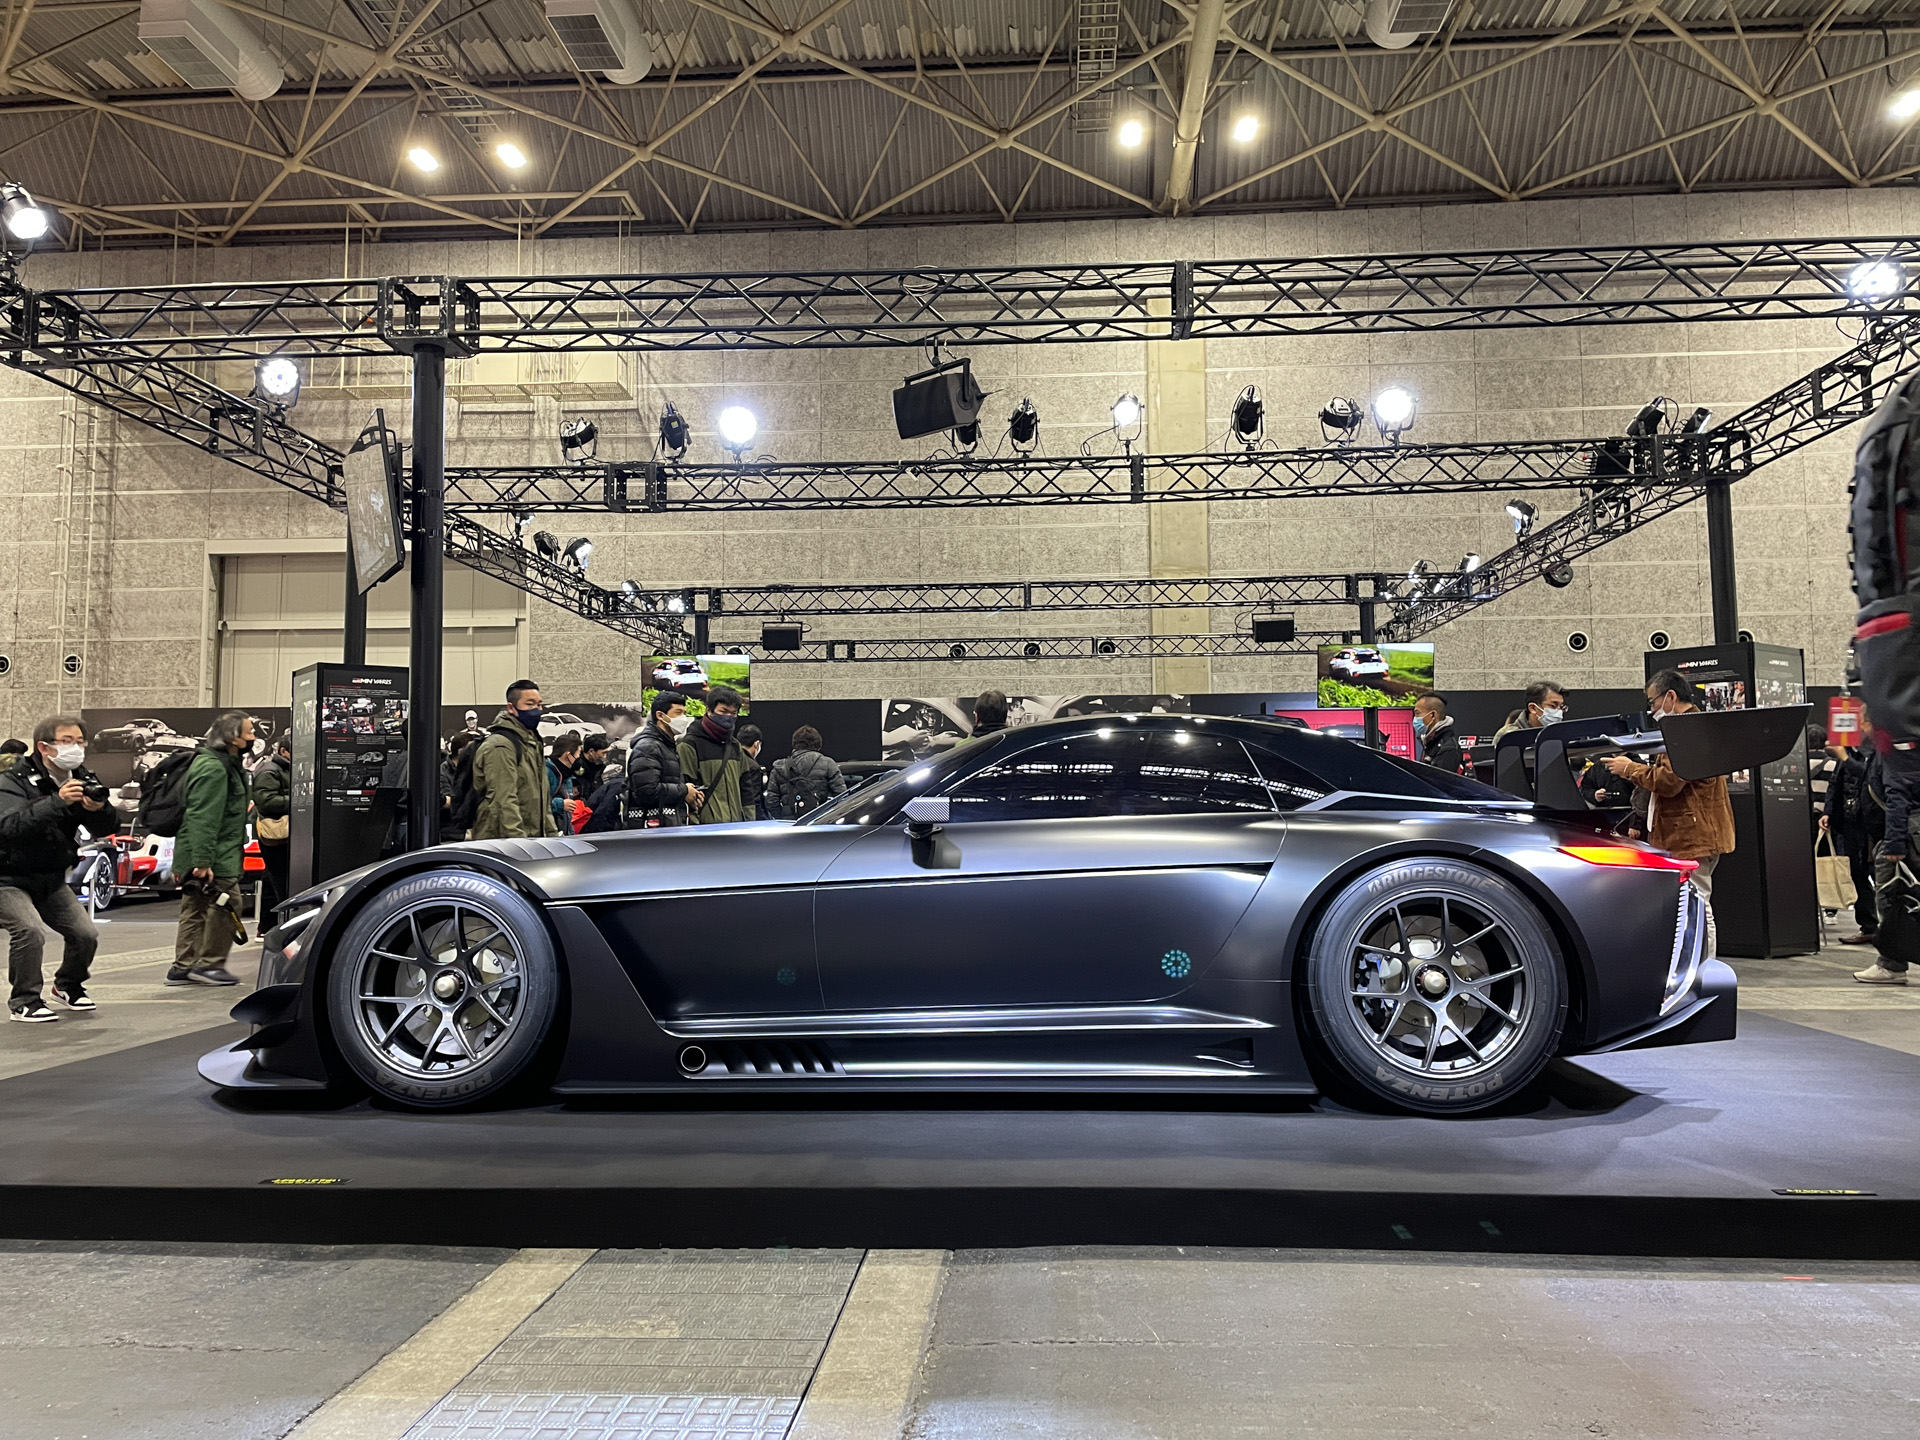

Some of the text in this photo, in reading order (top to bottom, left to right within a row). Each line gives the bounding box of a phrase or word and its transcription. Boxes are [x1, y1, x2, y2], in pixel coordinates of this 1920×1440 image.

[1699, 659, 1718, 667] YARIS
[1458, 738, 1476, 746] GR
[386, 876, 500, 907] BRIDGESTONE
[1367, 866, 1493, 896] BRIDGESTONE
[376, 1070, 493, 1099] POTENZA
[1375, 1065, 1504, 1100] POTENZA
